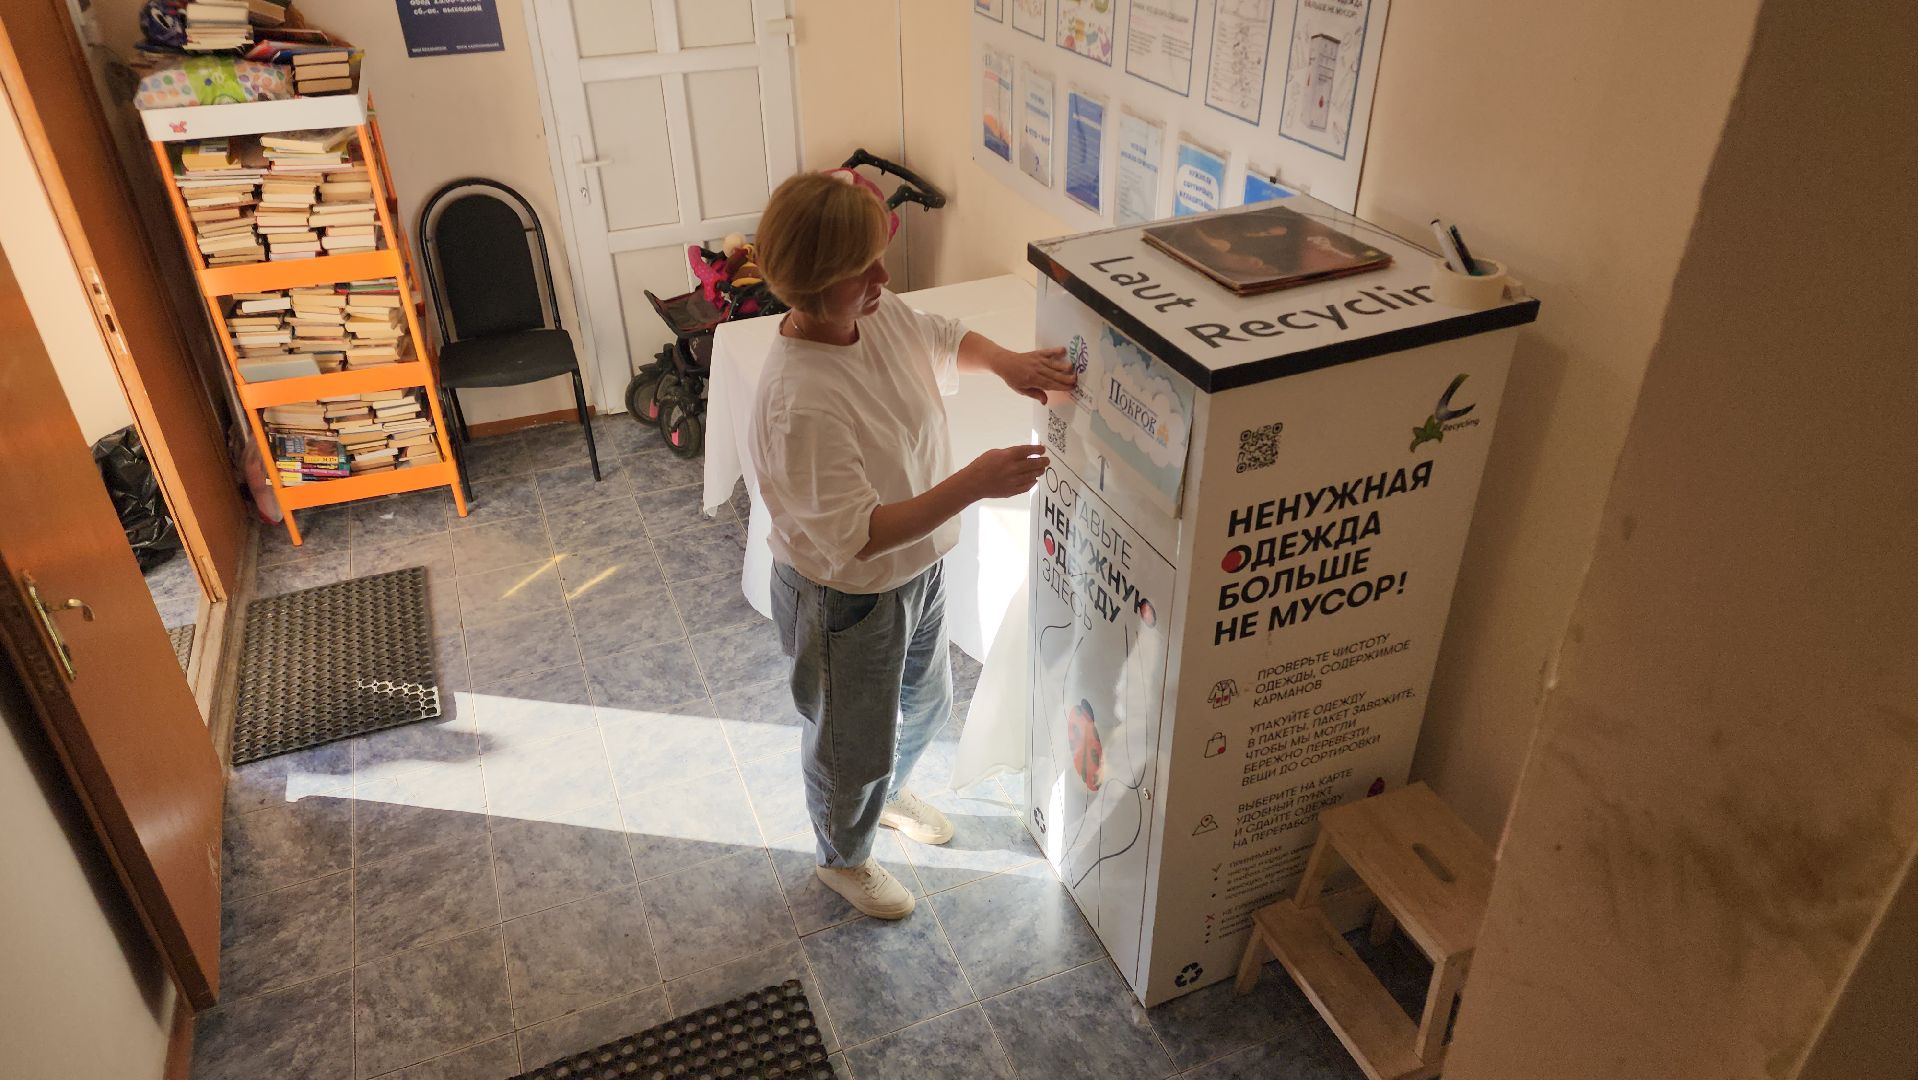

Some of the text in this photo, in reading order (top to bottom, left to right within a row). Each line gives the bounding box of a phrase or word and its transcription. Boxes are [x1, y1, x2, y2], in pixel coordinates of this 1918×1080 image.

[1090, 255, 1198, 313] Laut
[1045, 467, 1132, 570] ОСТАВЬТЕ
[1227, 460, 1434, 537] НЕНУЖНАЯ
[1045, 496, 1156, 628] НЕНУЖНУЮ
[1221, 510, 1381, 573] ОДЕЖДА
[1042, 557, 1093, 630] ЗДЕСЬ
[1218, 547, 1371, 611] БОЛЬШЕ
[1214, 571, 1408, 646] НЕ МУСОР!
[1257, 633, 1390, 681] ПРОВЕРЬТЕ ЧИСТОТУ
[1320, 640, 1412, 676] СОДЕРЖИМОЕ
[1249, 691, 1367, 736] УПАКУЙТЕ ОДЕЖДУ
[1253, 679, 1322, 708] КАРМАНОВ
[1243, 726, 1371, 775] БЕРЕЖНО ПЕРЕВЕЗТИ
[1245, 719, 1357, 761] ЧТОБЫ МЫ МОГЛИ
[1247, 738, 1256, 749] В
[1312, 708, 1349, 728] ПАКЕТ
[1241, 734, 1381, 787] ВЕЩИ ДО СОРТИРОВКИ
[1236, 786, 1334, 824] УДОБНЫЙ ПУНКТ
[1237, 768, 1354, 814] ВЫБЕРИТЕ НА КАРТЕ
[1234, 793, 1345, 838] И СДАЙТЕ ОДЕЖДУ
[1232, 836, 1248, 849] НА
